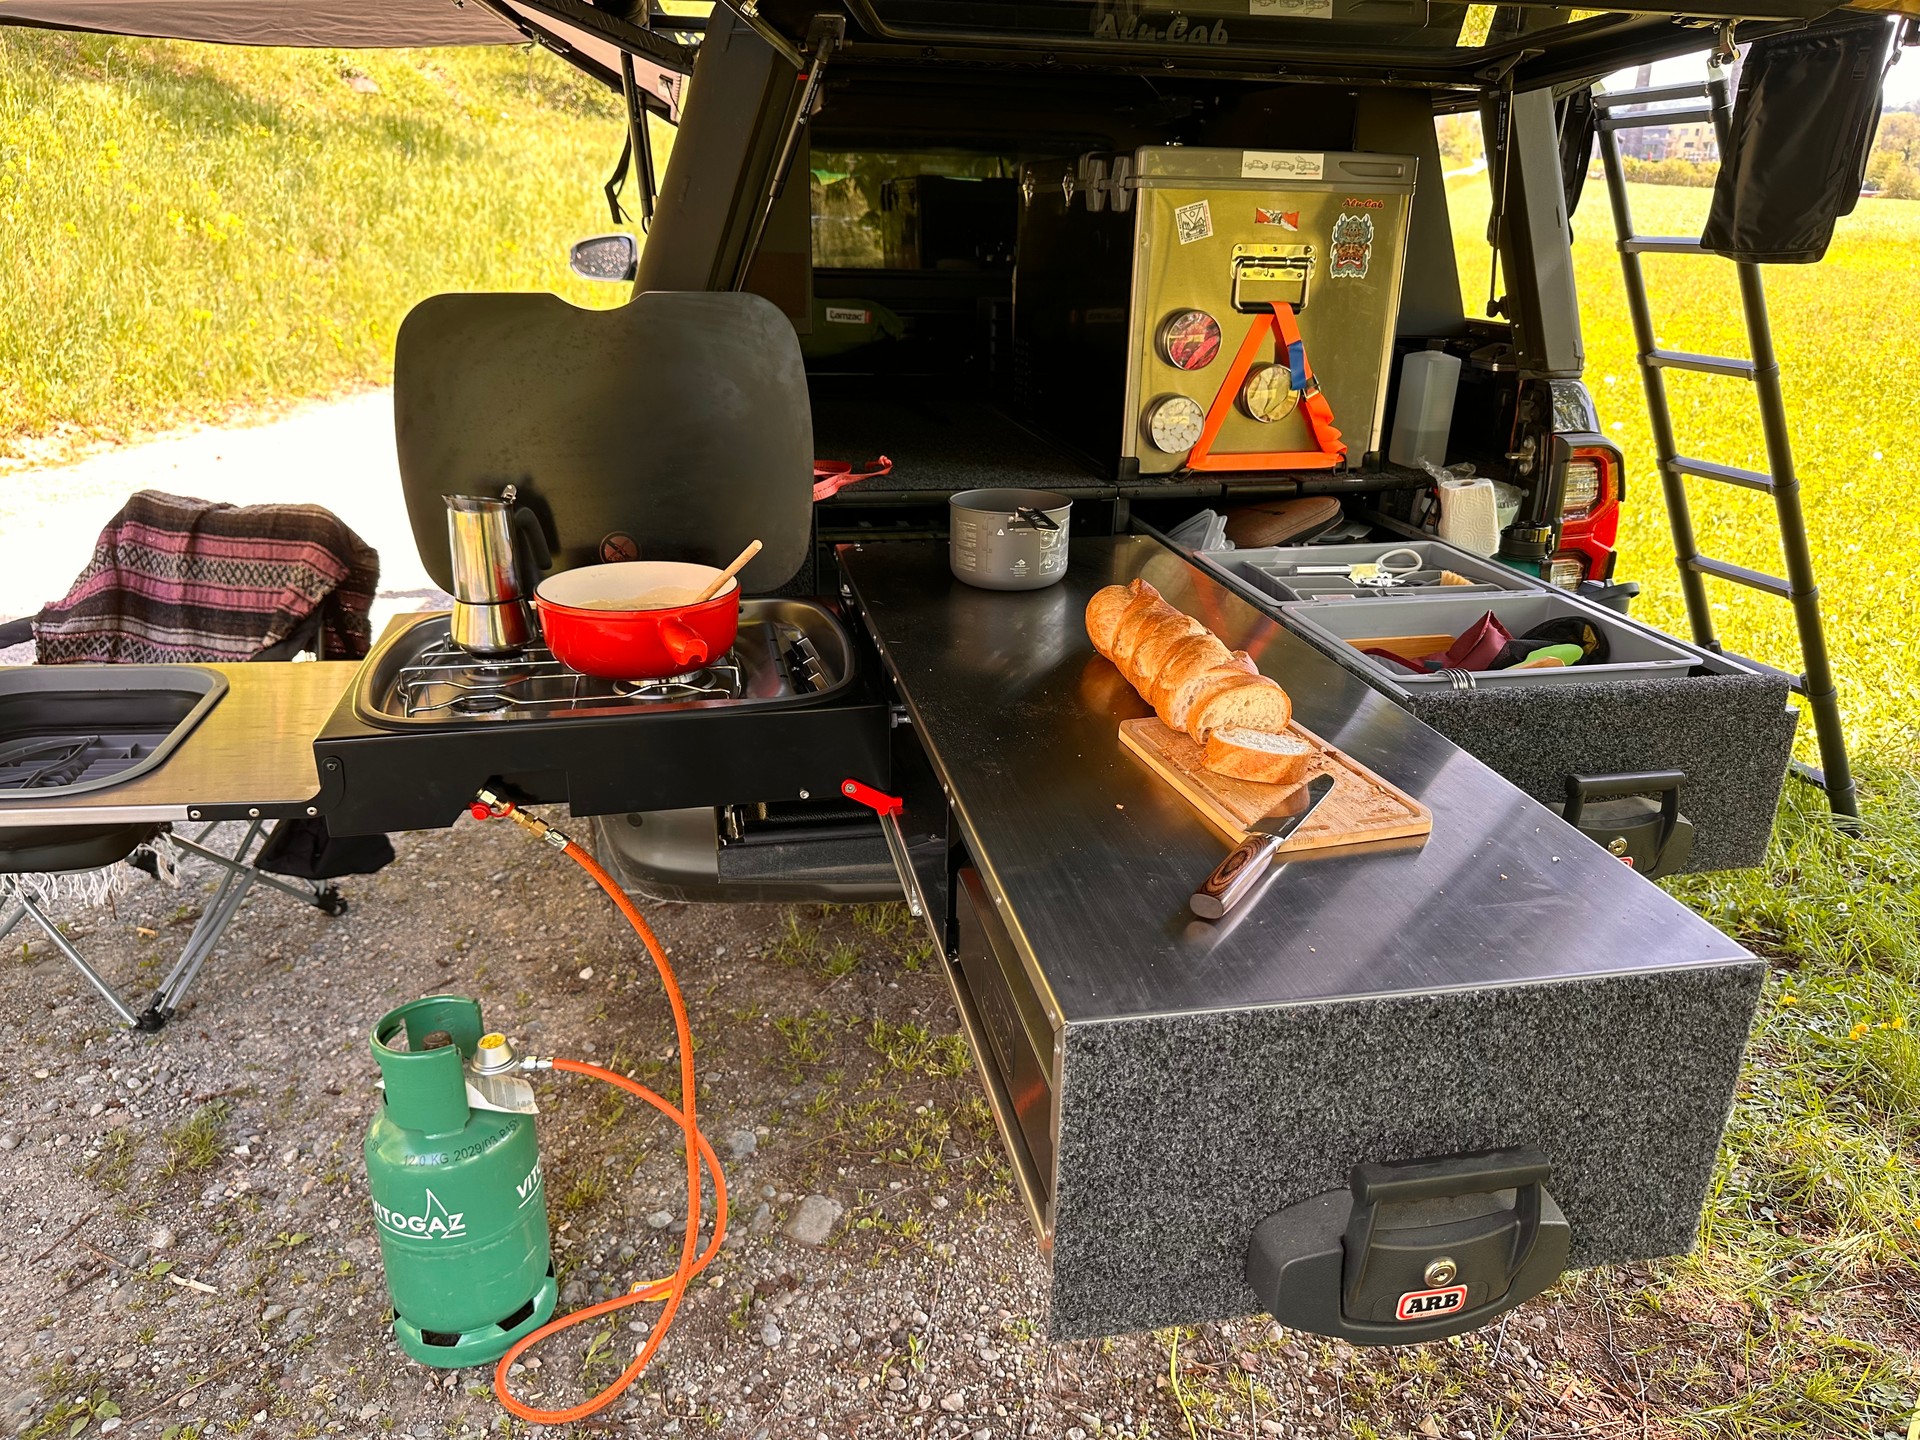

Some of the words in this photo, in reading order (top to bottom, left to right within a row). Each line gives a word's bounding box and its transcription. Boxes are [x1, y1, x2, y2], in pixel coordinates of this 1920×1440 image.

[1094, 14, 1229, 44] Alu-Cab
[1342, 198, 1385, 209] Alu-Cab
[431, 1153, 449, 1166] KG
[454, 1135, 499, 1162] 2029/03
[1406, 1293, 1459, 1314] ARB
